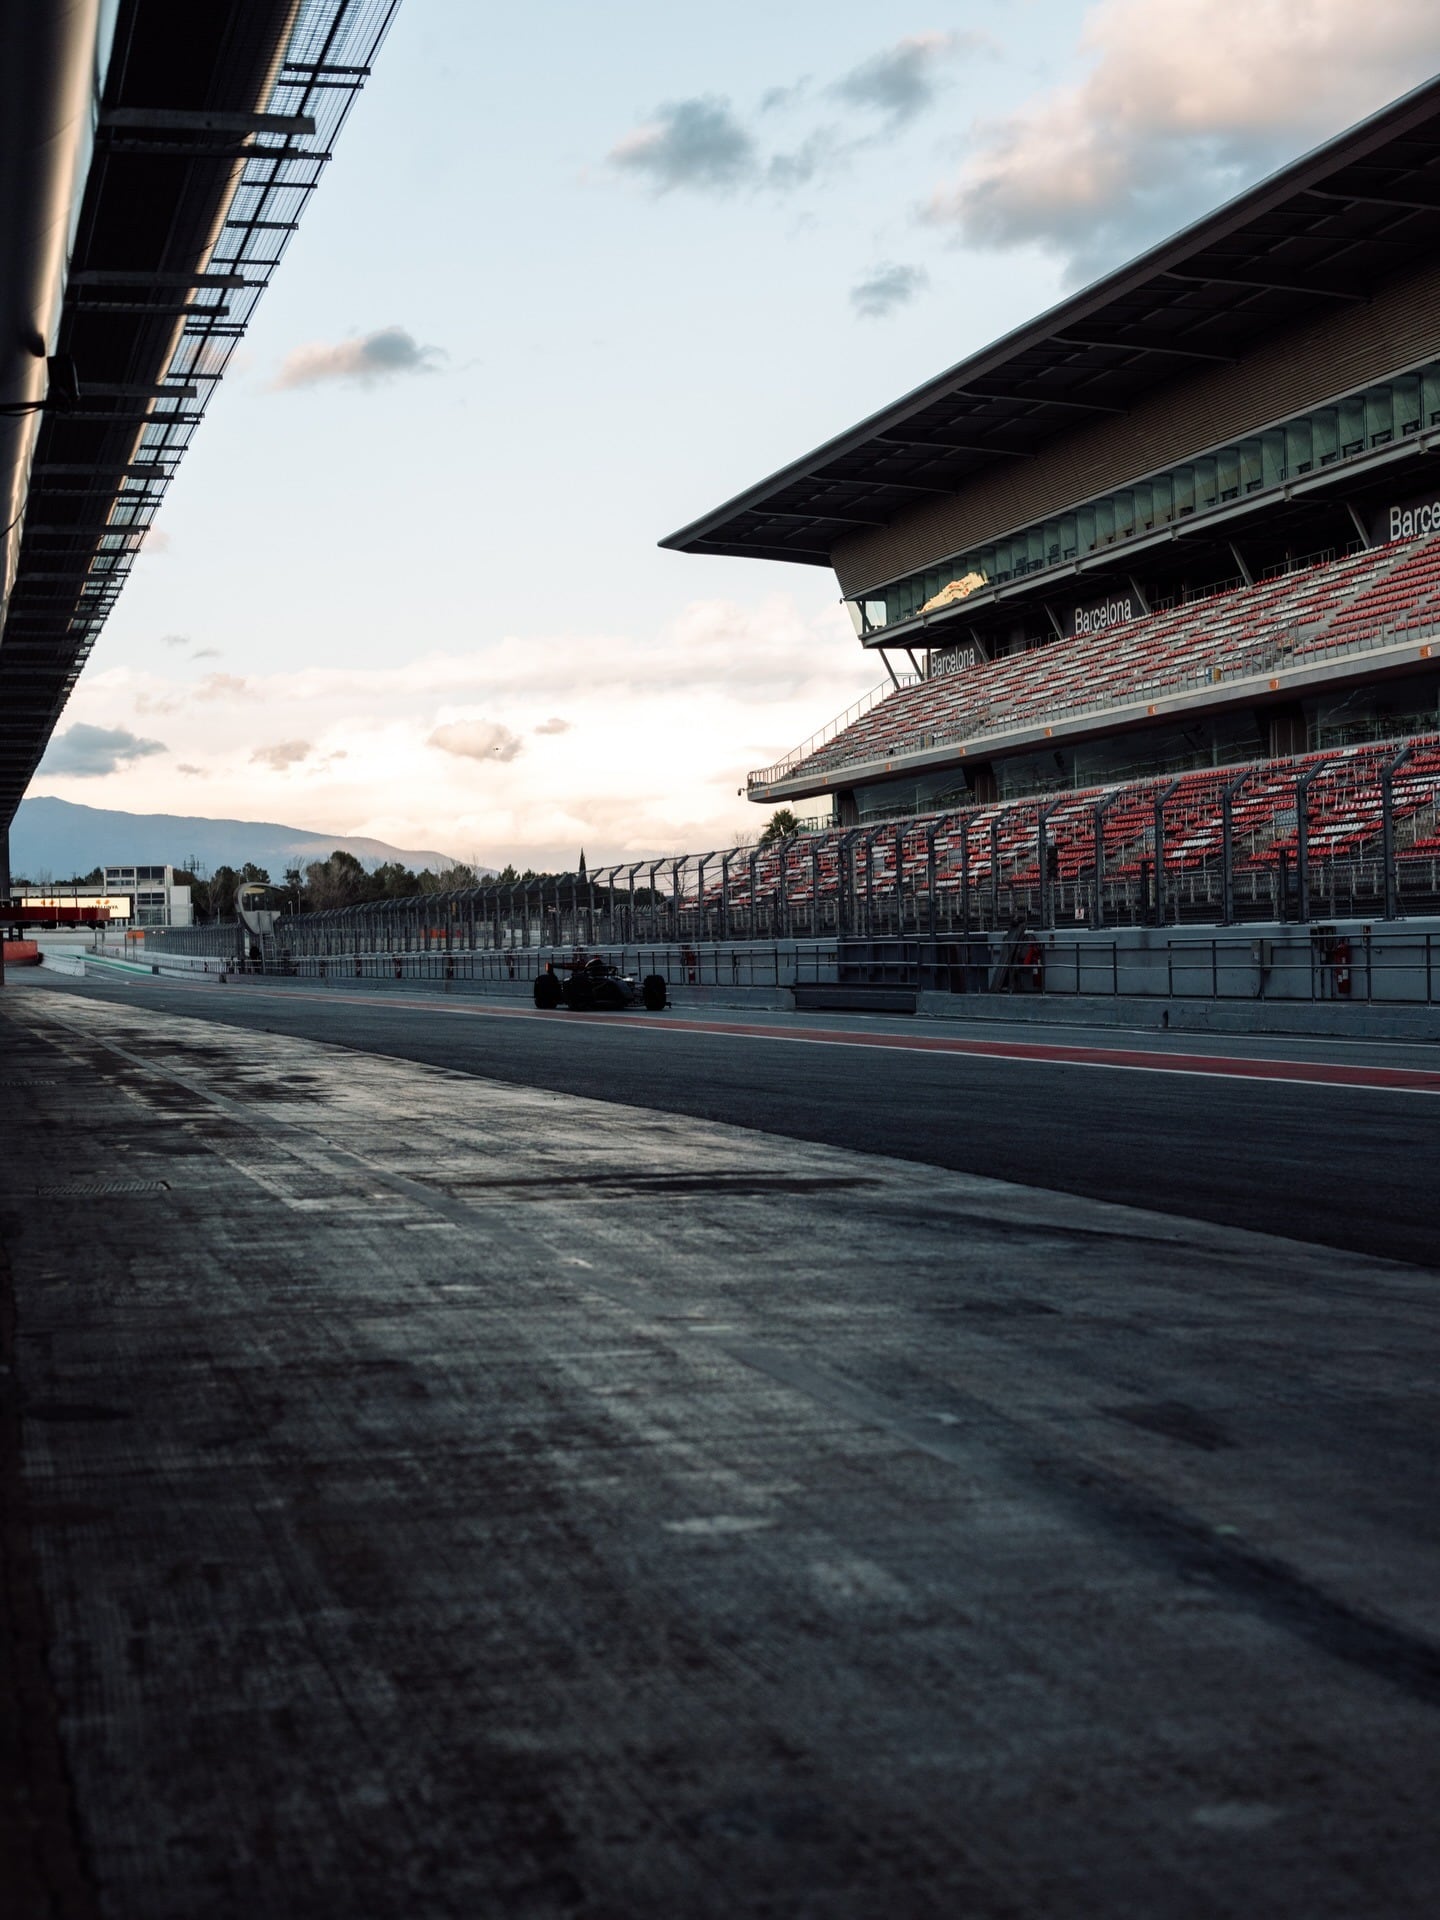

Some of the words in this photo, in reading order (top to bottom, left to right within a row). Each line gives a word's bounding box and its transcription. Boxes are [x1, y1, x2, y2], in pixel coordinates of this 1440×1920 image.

[1389, 501, 1440, 542] Barce
[1075, 597, 1132, 635] Barcelona
[931, 645, 975, 678] Barcelona
